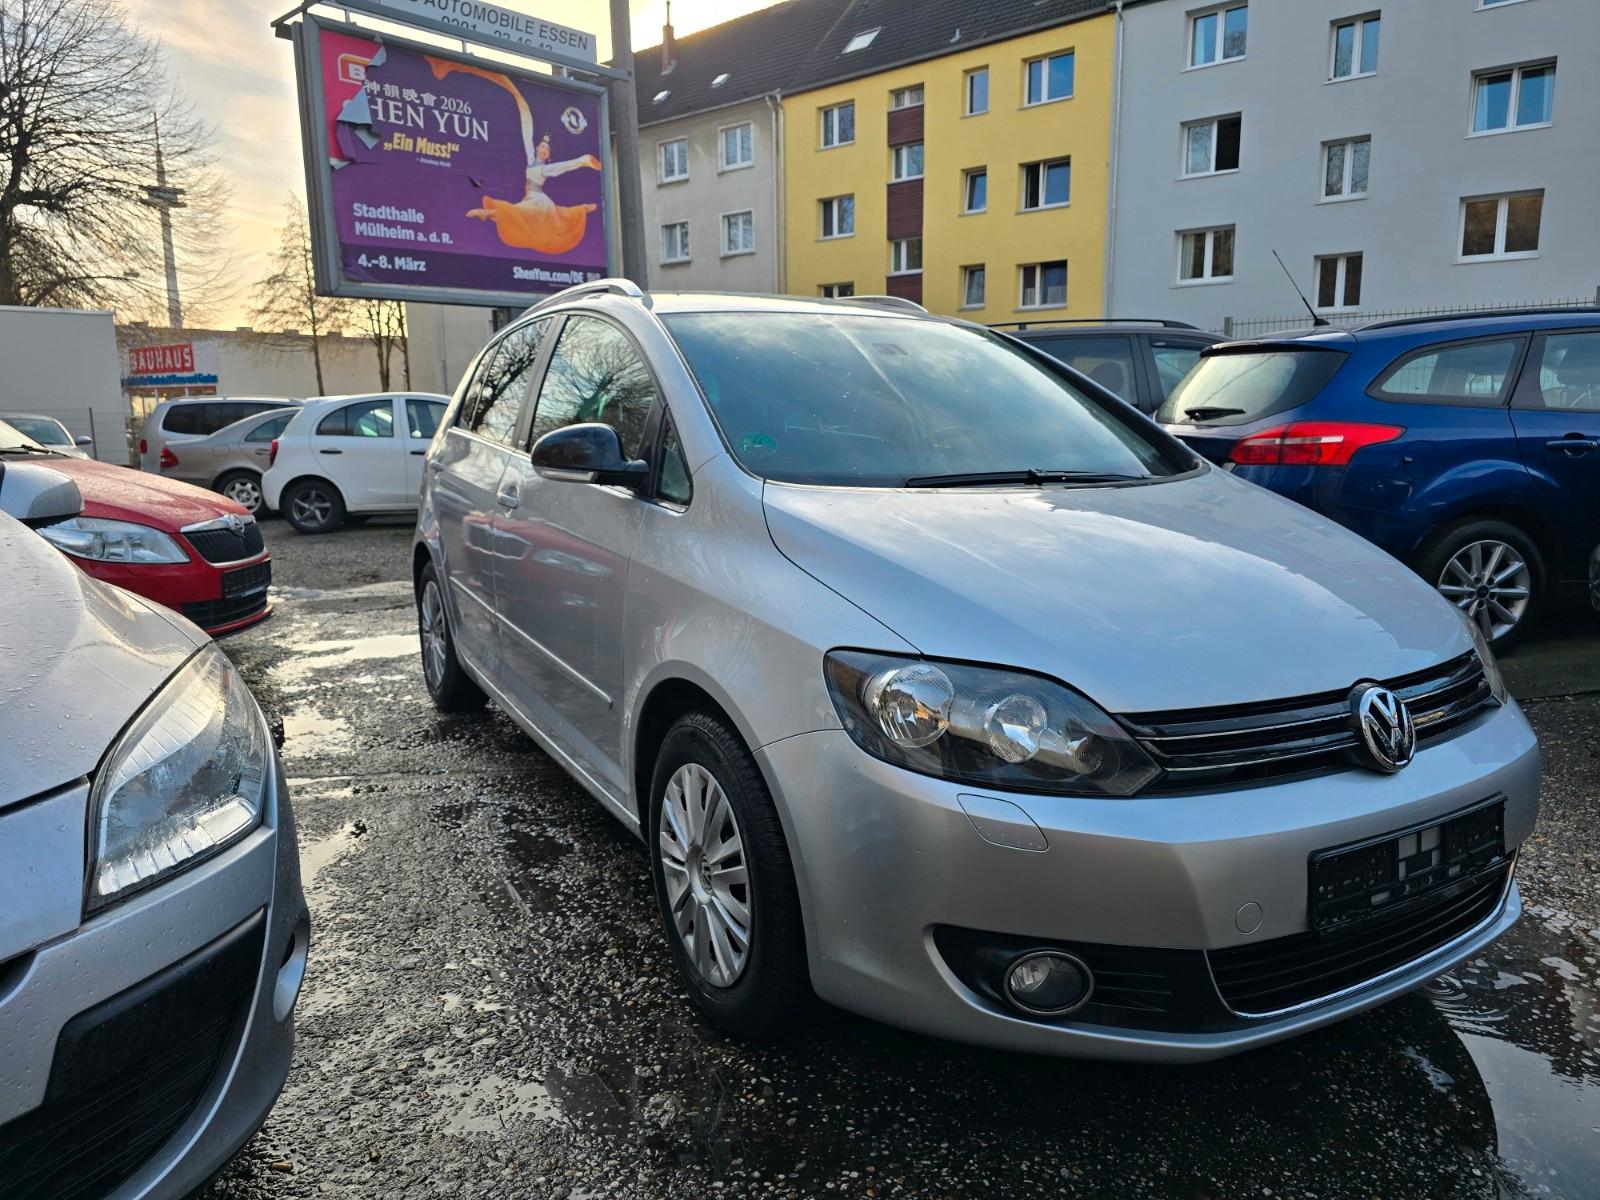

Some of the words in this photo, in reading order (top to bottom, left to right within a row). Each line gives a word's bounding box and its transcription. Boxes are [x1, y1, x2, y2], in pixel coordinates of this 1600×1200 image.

[424, 0, 533, 35] AUTOMOBILE
[540, 24, 588, 50] ESSEN
[440, 96, 472, 115] 2026
[370, 96, 424, 129] HEN
[432, 109, 488, 142] YUN
[353, 203, 425, 223] Stadthalle
[354, 216, 415, 240] Mülheim
[417, 231, 428, 242] a.
[429, 231, 441, 243] d.
[441, 233, 453, 244] R.
[394, 256, 427, 271] März
[512, 266, 585, 285] ShenYun.com/DE
[130, 347, 192, 371] BAUHAUS
